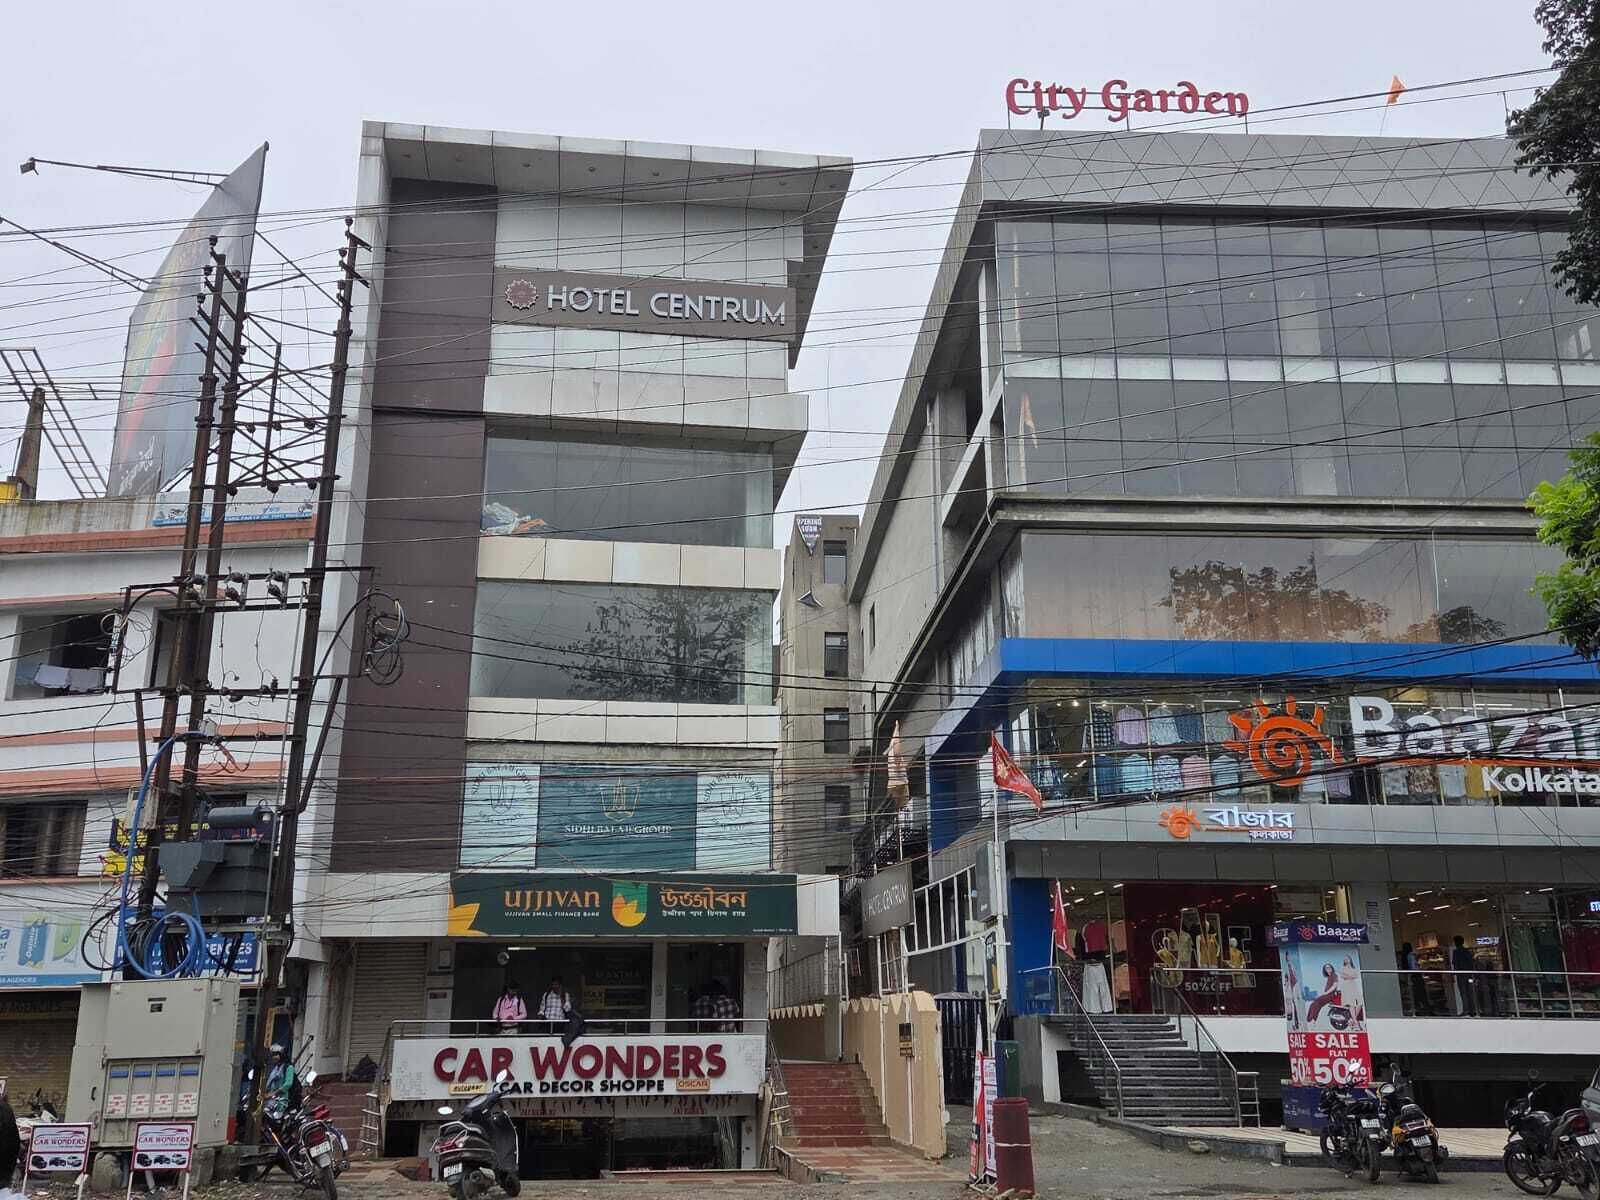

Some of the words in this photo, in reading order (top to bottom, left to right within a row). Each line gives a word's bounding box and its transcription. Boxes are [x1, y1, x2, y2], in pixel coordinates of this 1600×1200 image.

[1006, 78, 1086, 120] City
[1102, 79, 1249, 122] Garden
[547, 285, 640, 315] HOTEL
[650, 292, 786, 326] CENTRUM
[1482, 767, 1600, 793] Kolkata
[1209, 805, 1294, 829] বাজার
[1317, 924, 1364, 937] Baazar
[1315, 1034, 1359, 1049] SALE
[1329, 1050, 1348, 1058] FLAT
[433, 1047, 516, 1083] CAR
[530, 1044, 727, 1080] WONDERS
[500, 1081, 533, 1095] CAR
[541, 1080, 595, 1094] DECOR
[599, 1079, 665, 1092] SHOPPE
[33, 1137, 49, 1146] CAR
[51, 1136, 87, 1145] WONDERS
[139, 1136, 153, 1144] CAR
[155, 1136, 190, 1144] WONDERS
